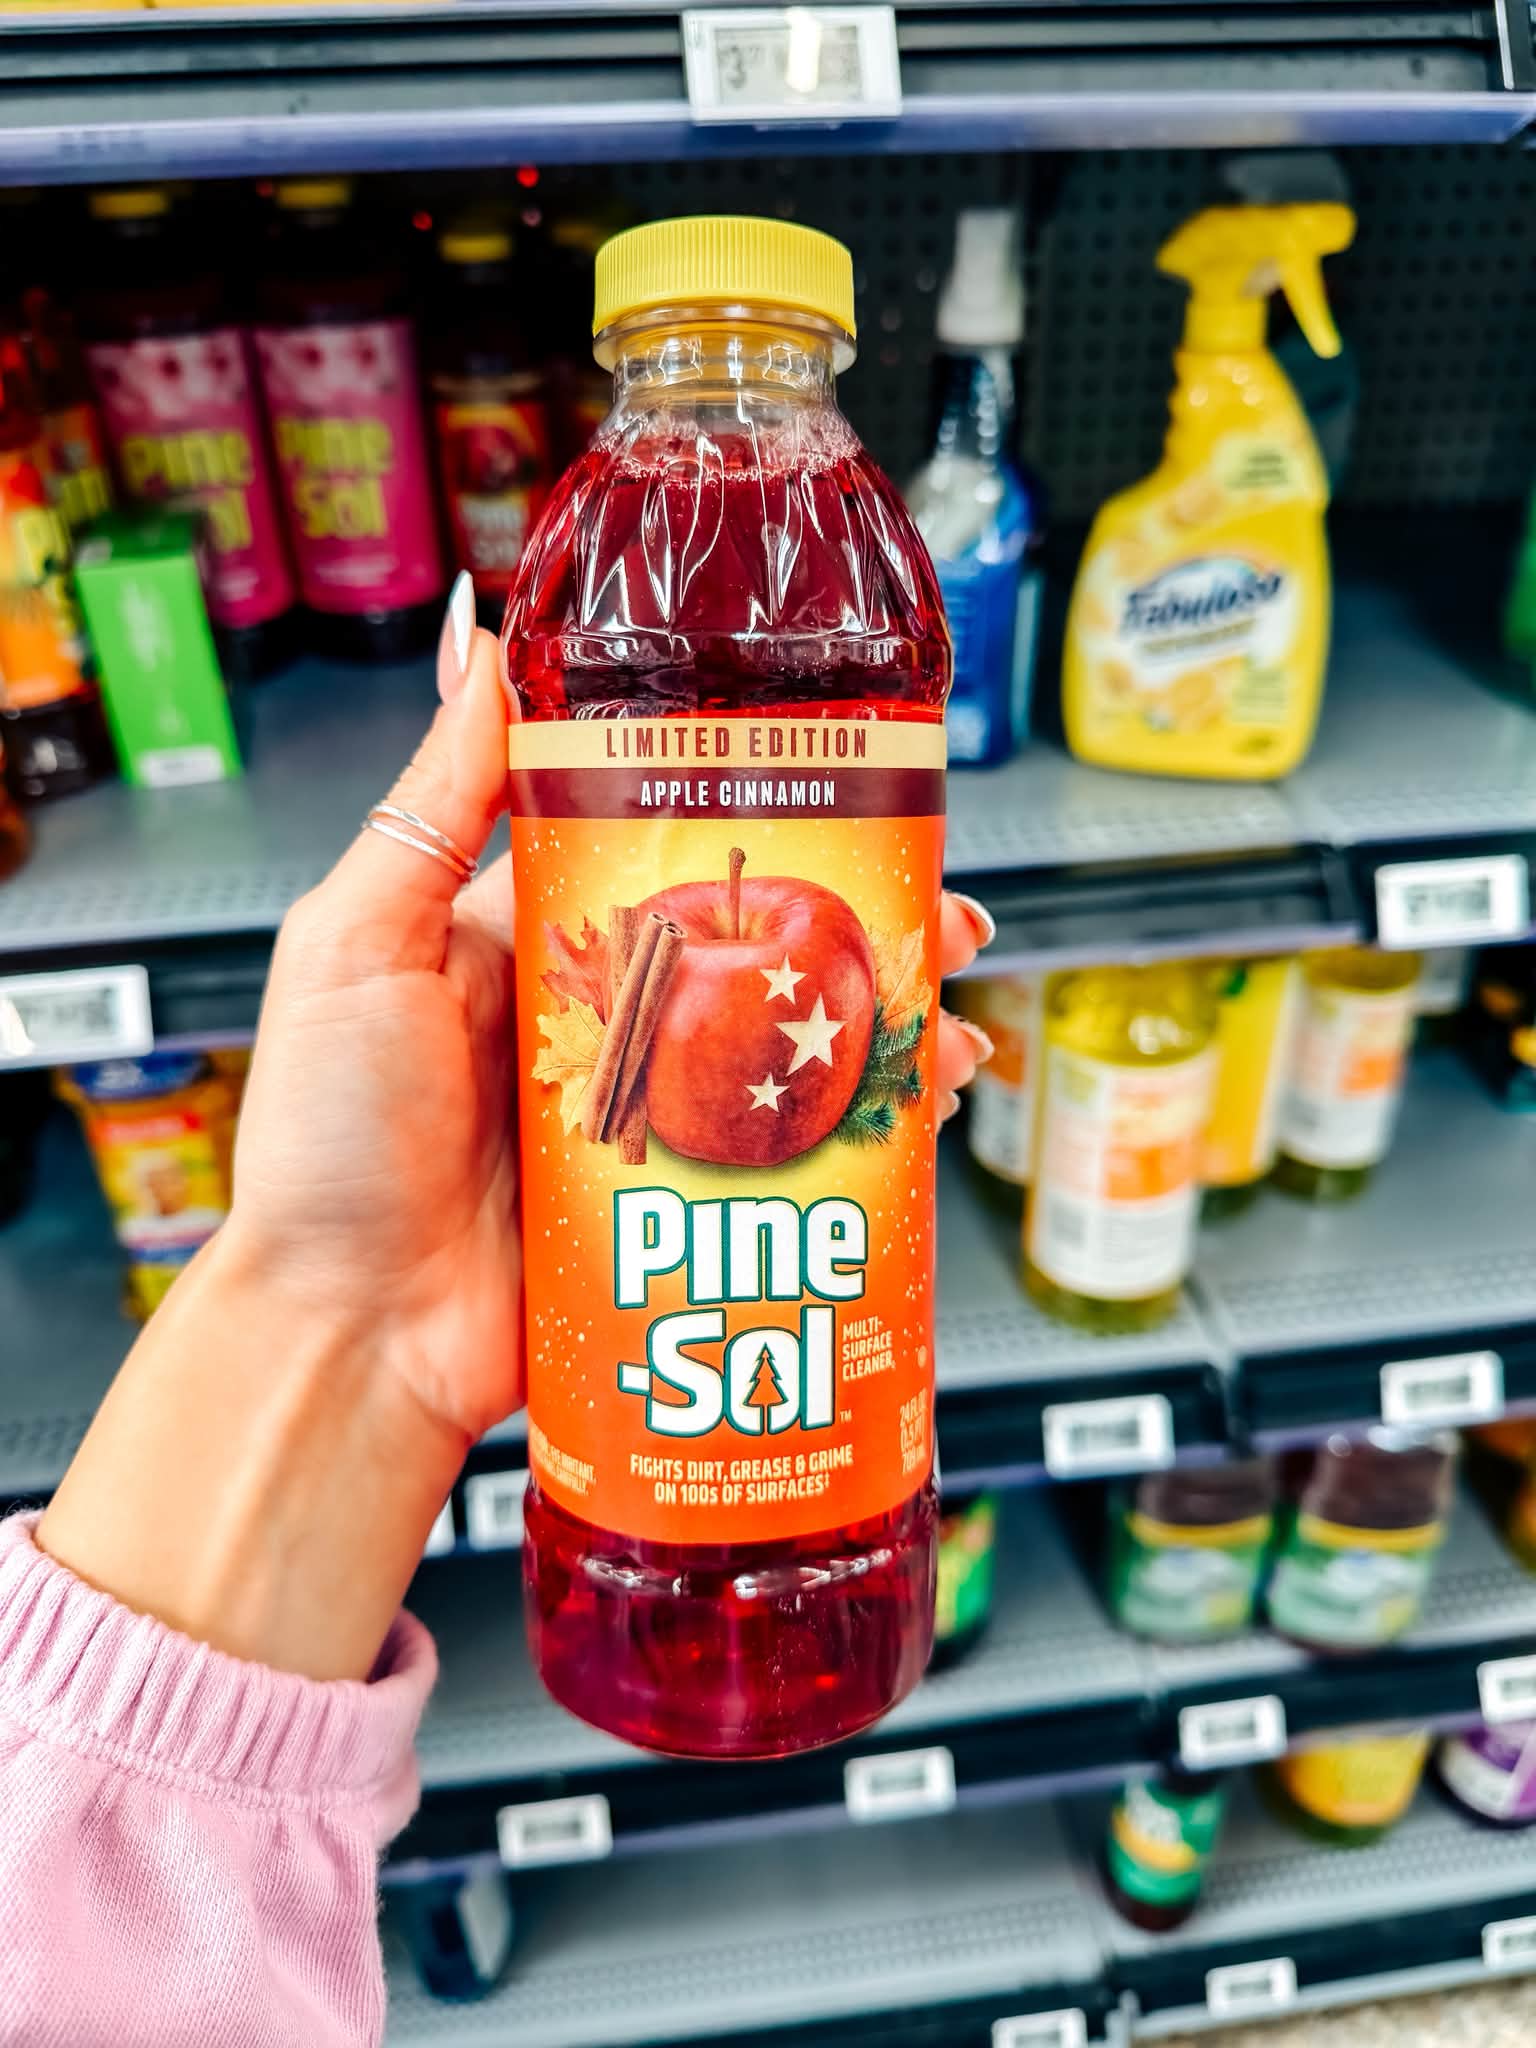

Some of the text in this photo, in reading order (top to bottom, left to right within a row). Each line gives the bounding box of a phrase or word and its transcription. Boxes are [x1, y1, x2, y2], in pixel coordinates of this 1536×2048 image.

[606, 727, 867, 758] LIMITED EDITION
[640, 780, 835, 807] APPLE CINNAMON
[614, 1185, 869, 1310] Pine
[841, 1315, 884, 1342] MULTI-
[841, 1330, 893, 1362] SURFACE
[839, 1408, 852, 1422] TM
[629, 1443, 855, 1486] FIGHTS DIRT, GREASE & GRIME
[653, 1481, 678, 1505] ON
[679, 1482, 719, 1506] 100s
[721, 1481, 744, 1506] OF
